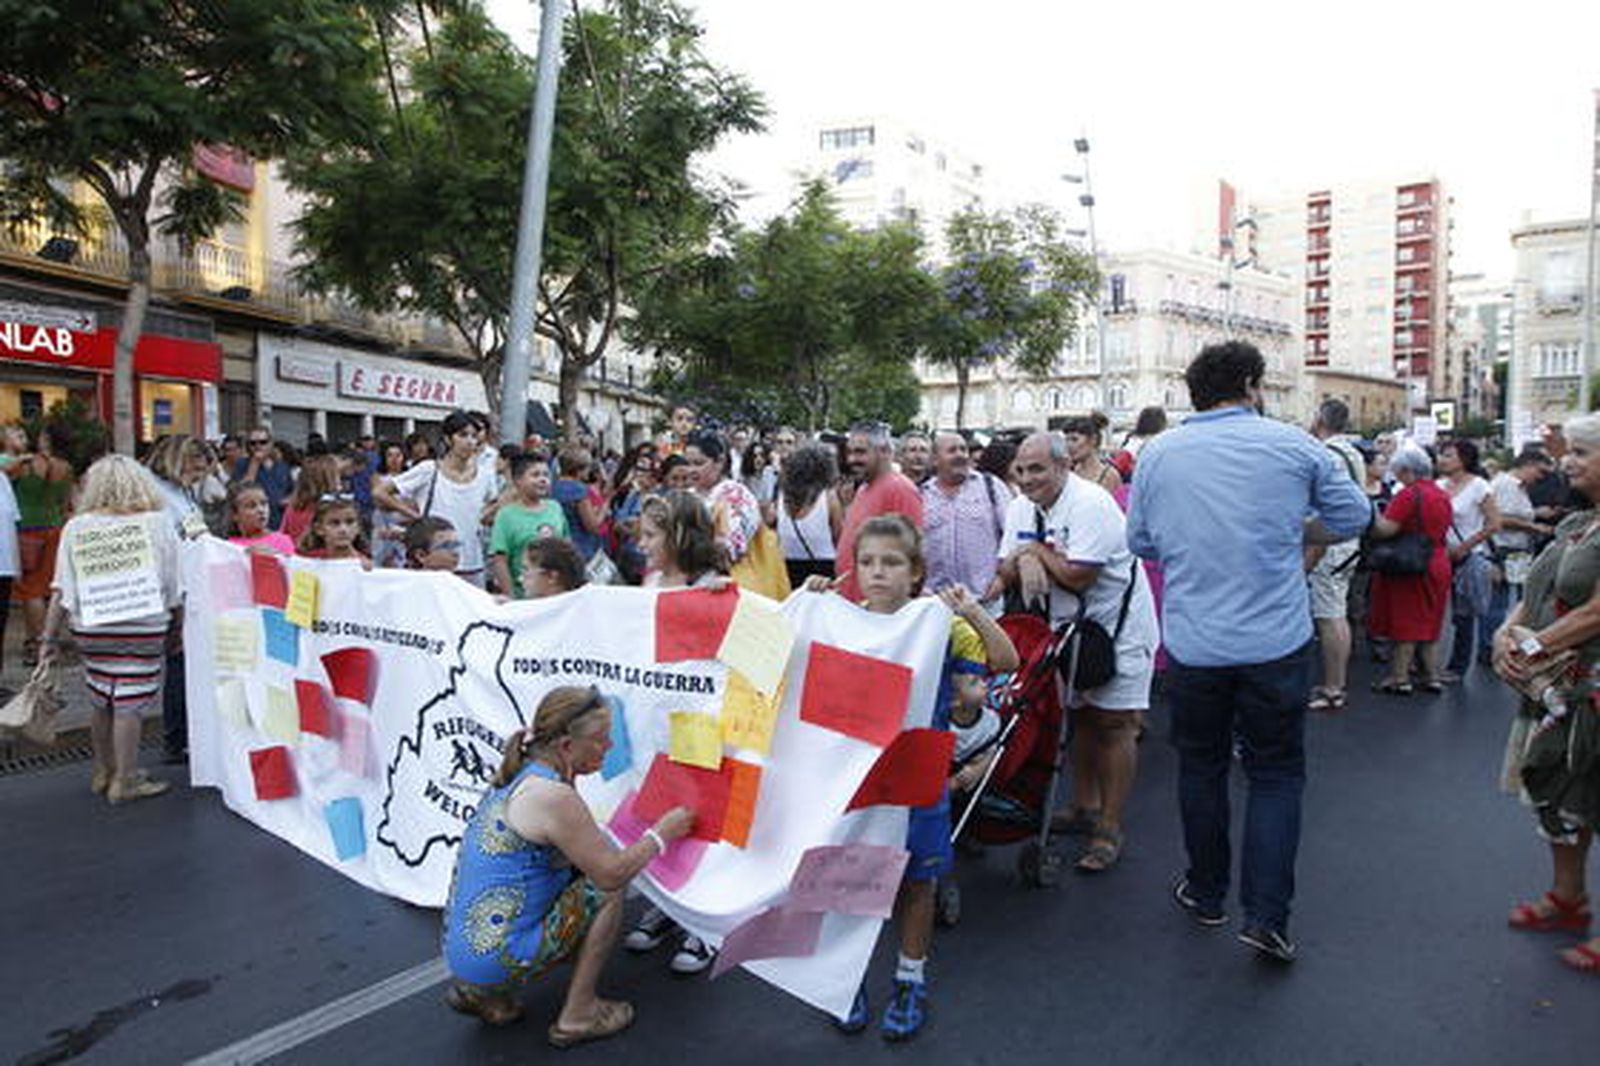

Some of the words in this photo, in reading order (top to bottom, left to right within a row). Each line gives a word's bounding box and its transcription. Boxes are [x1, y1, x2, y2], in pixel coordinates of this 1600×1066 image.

[377, 373, 457, 403] SEGURA
[562, 658, 622, 681] CONTRA
[624, 667, 641, 686] LA
[643, 671, 716, 695] GUERRA
